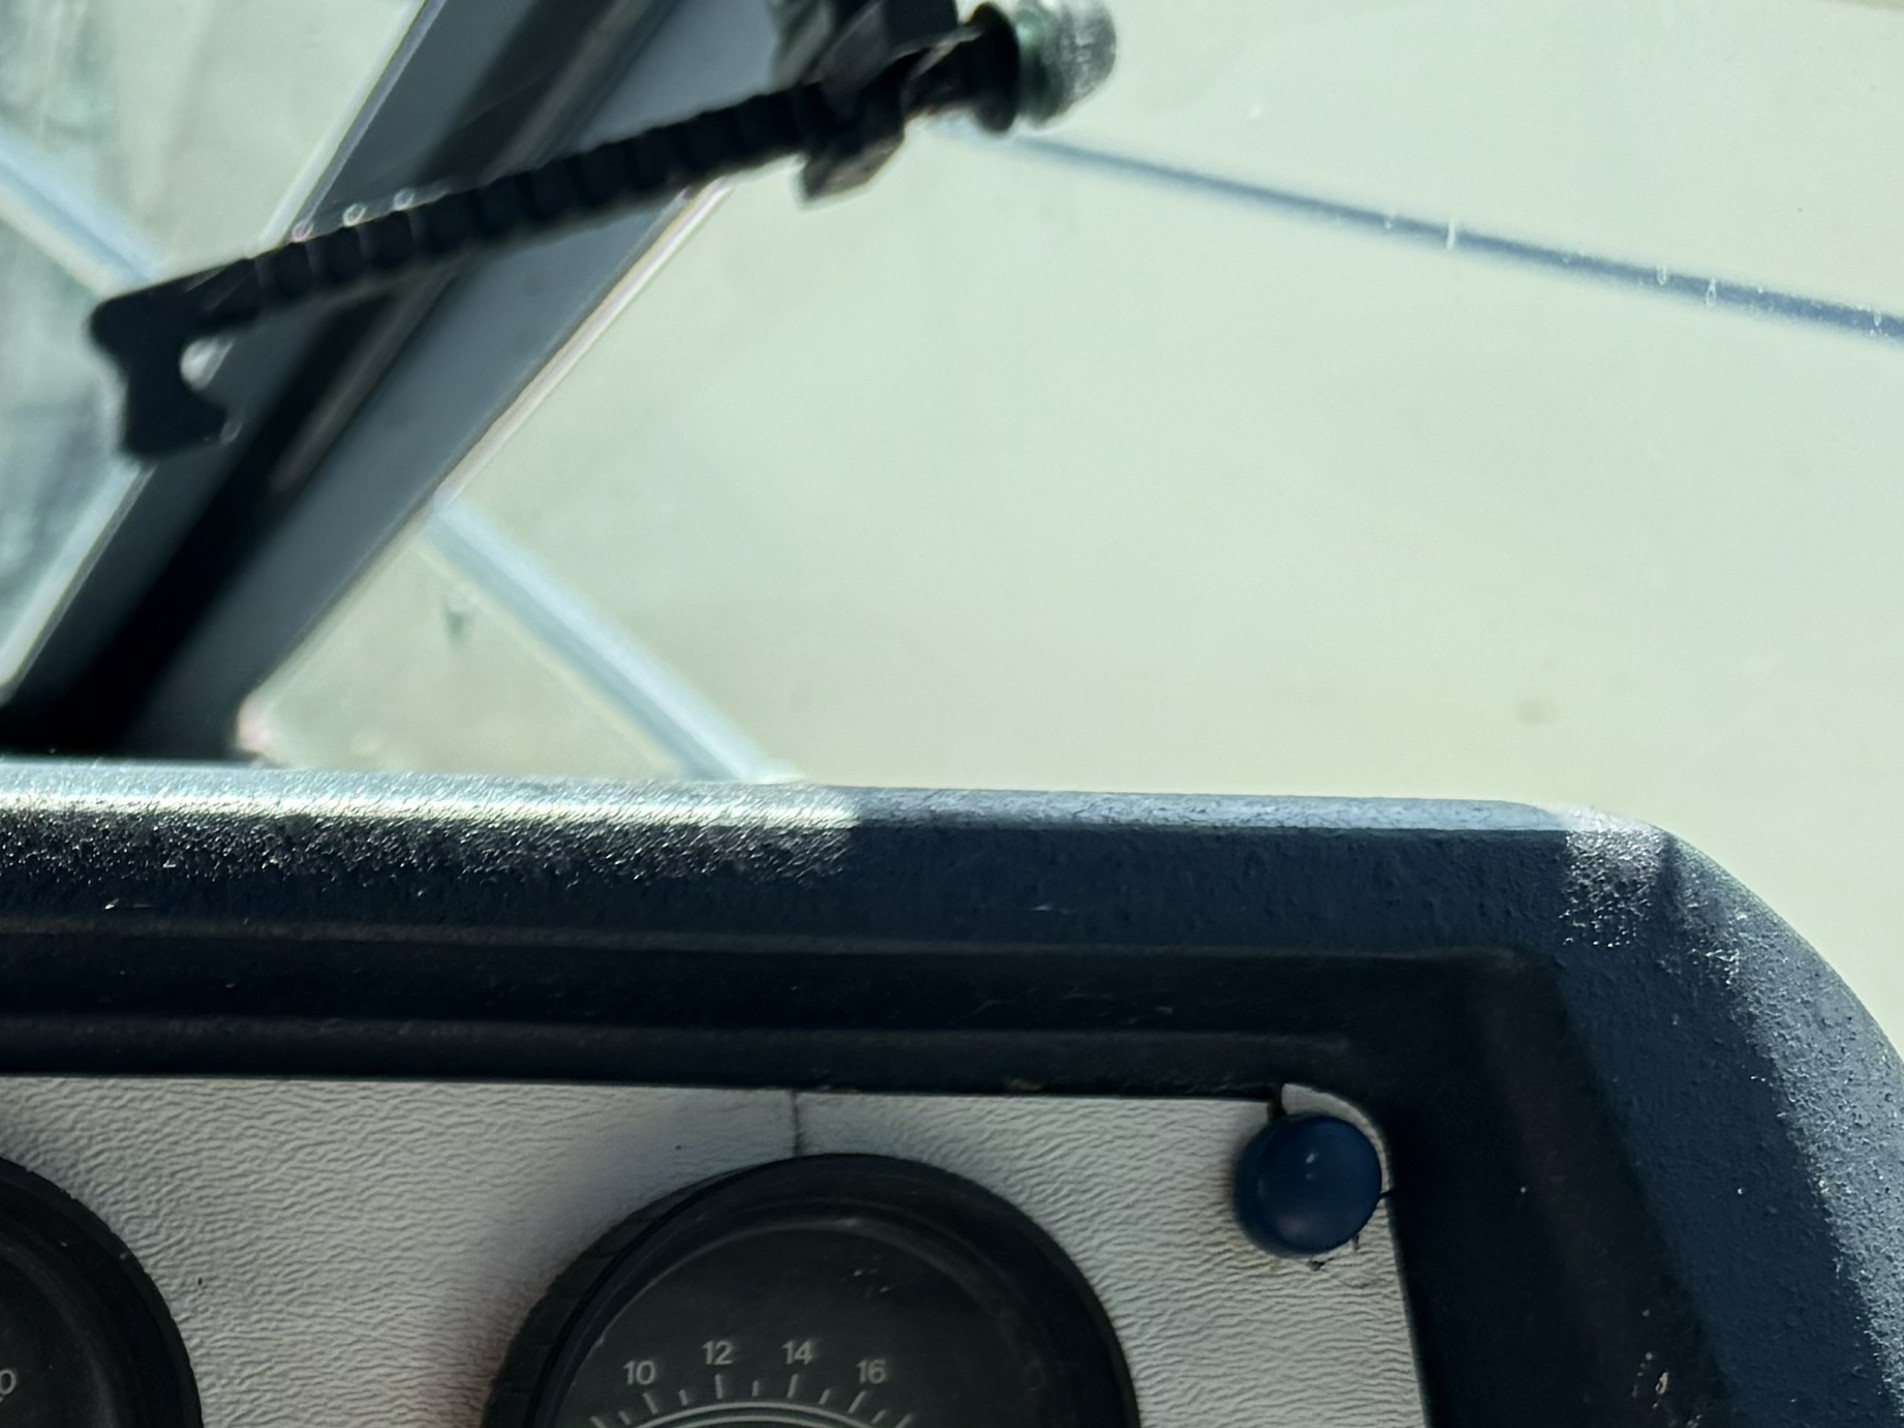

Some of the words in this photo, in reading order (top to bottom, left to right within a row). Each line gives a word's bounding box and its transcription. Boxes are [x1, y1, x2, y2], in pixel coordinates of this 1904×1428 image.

[702, 1341, 734, 1365] 12
[782, 1341, 814, 1365] 14
[623, 1360, 656, 1385] 10
[856, 1360, 888, 1384] 16
